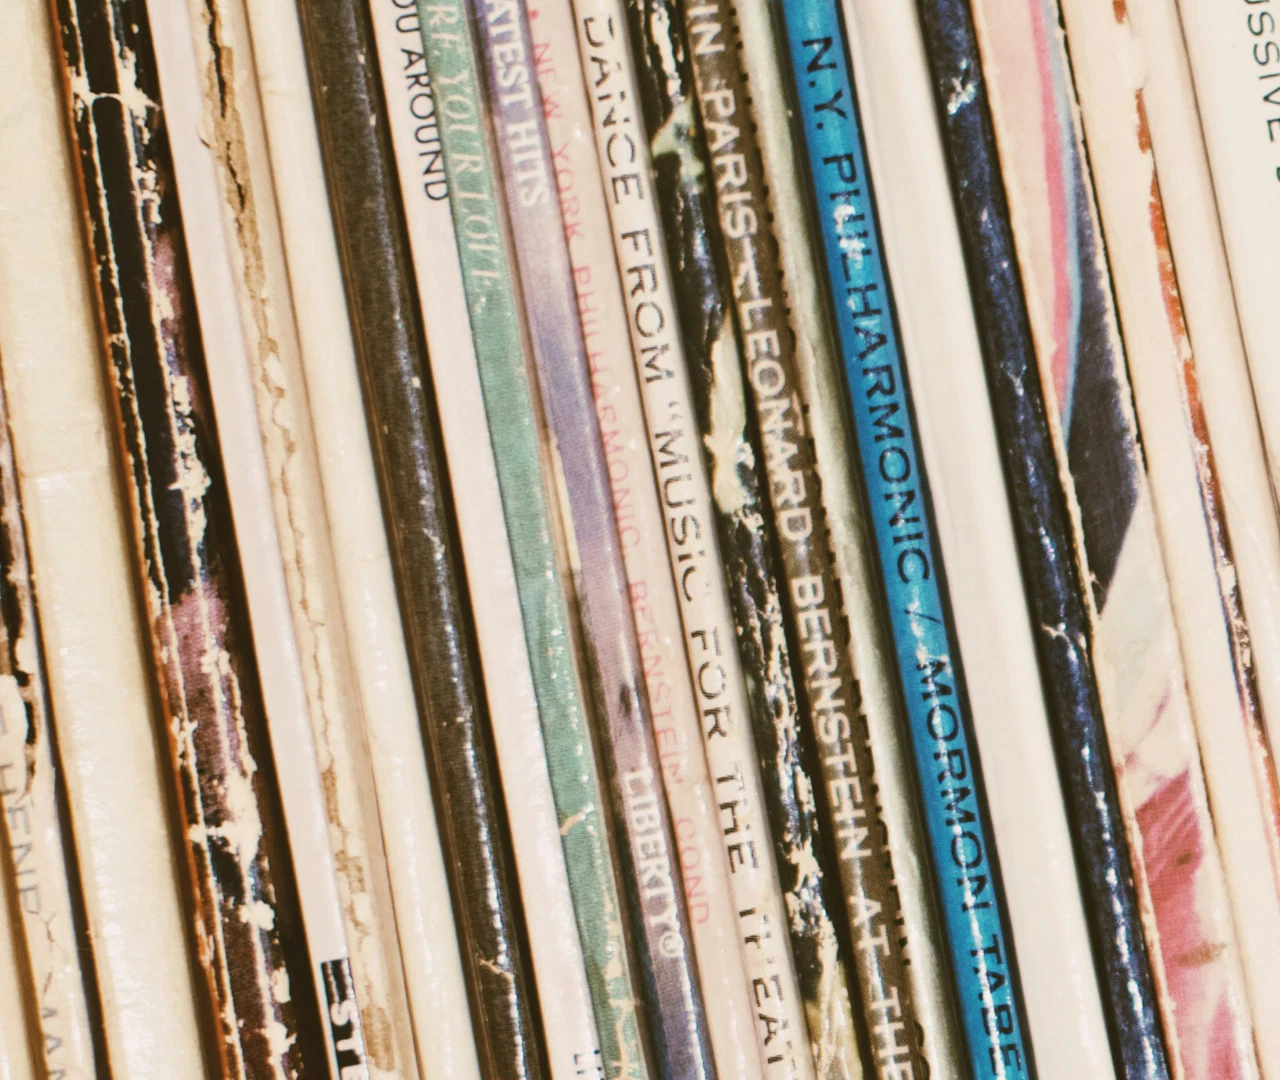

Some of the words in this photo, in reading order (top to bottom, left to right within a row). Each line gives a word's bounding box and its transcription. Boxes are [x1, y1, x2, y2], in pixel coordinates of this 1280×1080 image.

[399, 45, 450, 204] AROUND
[436, 67, 485, 176] YOUR
[505, 118, 551, 210] HITS
[530, 41, 564, 122] NEW
[549, 142, 586, 244] YORK
[800, 35, 846, 132] N.Y.
[820, 151, 930, 586] PHILHARMONIC
[619, 227, 675, 386] FROM
[688, 624, 736, 742] FOR
[684, 2, 725, 57] IN
[789, 574, 872, 862] BERNSTEIN
[848, 891, 890, 962] AT
[712, 769, 761, 877] THE
[914, 654, 992, 916] MORMON
